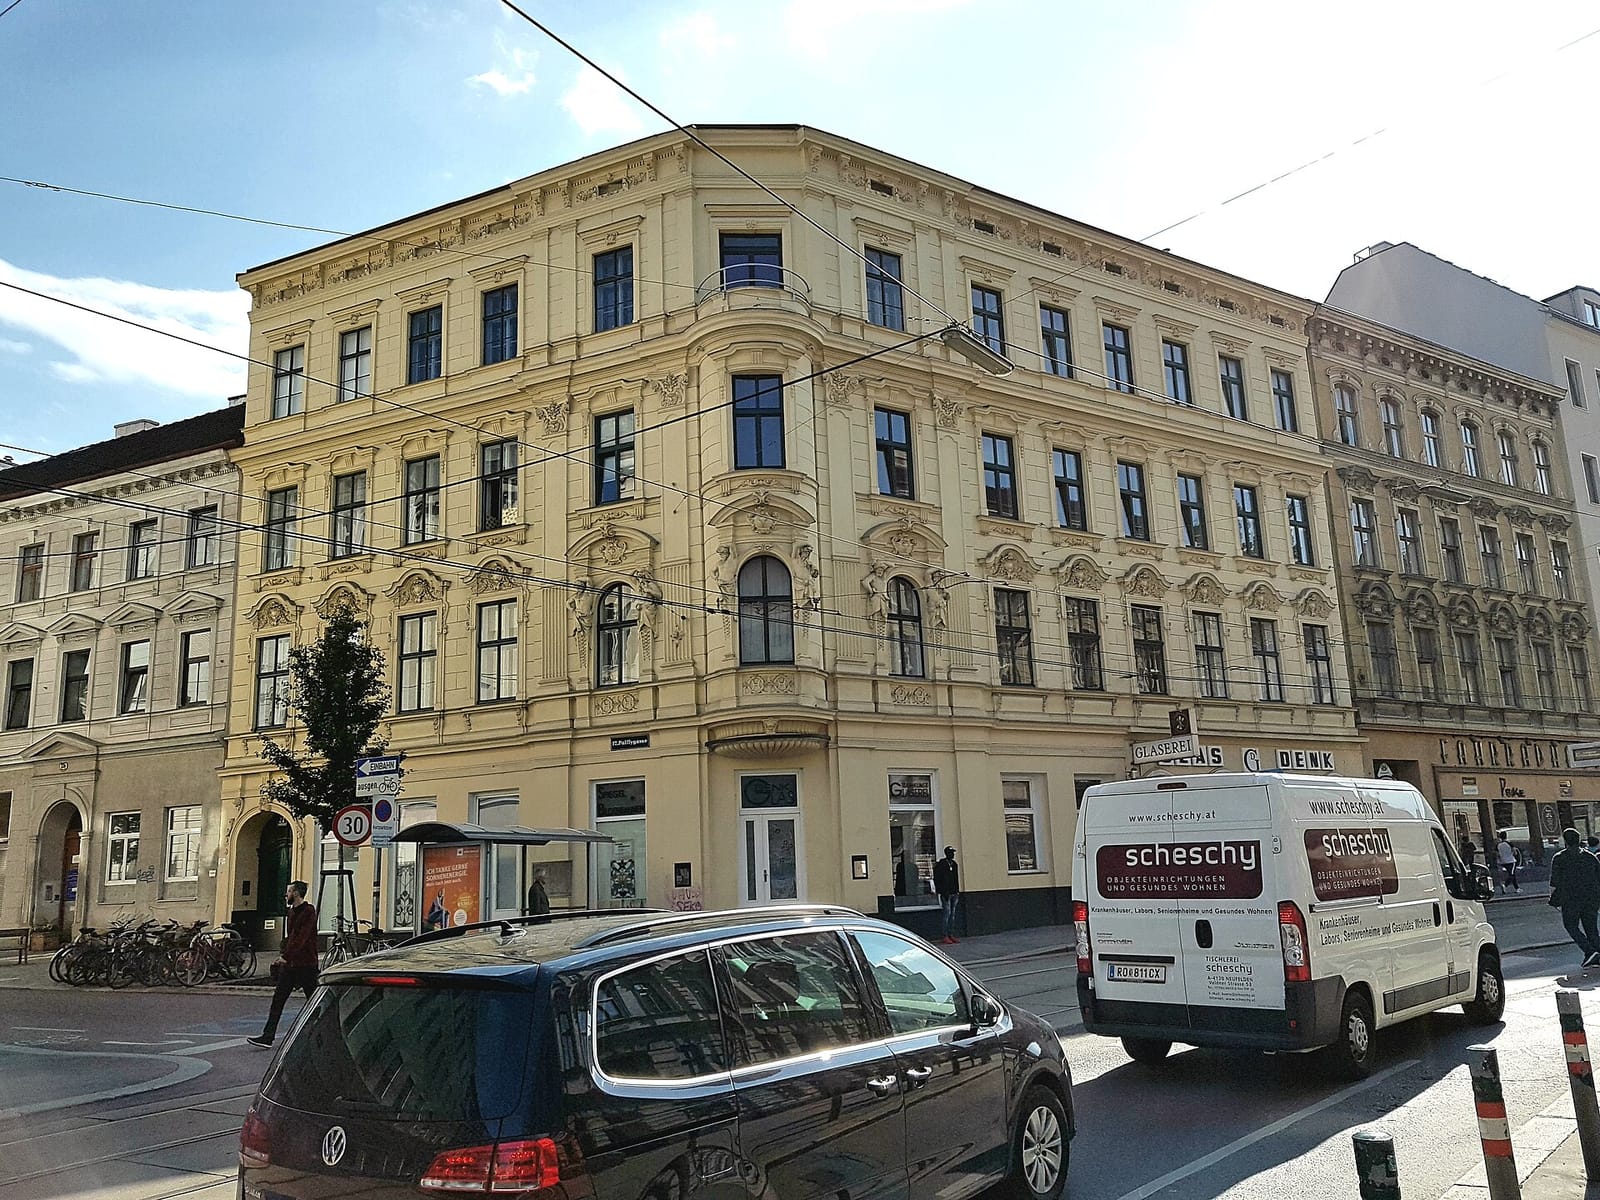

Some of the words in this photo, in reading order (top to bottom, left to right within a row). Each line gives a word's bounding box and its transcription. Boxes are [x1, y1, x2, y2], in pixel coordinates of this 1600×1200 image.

[1135, 740, 1192, 759] GLASEREI
[370, 762, 395, 771] EINBAHN
[1159, 748, 1221, 764] AS
[1280, 751, 1333, 770] DENK
[1309, 797, 1385, 818] www.scheschy.at
[1129, 810, 1216, 822] www.scheschy.at
[343, 816, 363, 834] 30
[1322, 829, 1392, 861] scheschy
[1126, 843, 1256, 870] scheschy
[1106, 875, 1225, 883] OBJEKTEINRICHTUNGEN
[1317, 867, 1382, 880] OBJEKTEINRICHTUNGEN
[1333, 880, 1361, 889] GESUNDES
[1091, 906, 1133, 914] Krankenhäuser,
[1134, 907, 1156, 915] Labors,
[1320, 913, 1362, 930] Krankenhäuser,
[1320, 933, 1343, 946] Labors,
[1343, 926, 1381, 942] Seniorenheime
[1382, 924, 1391, 934] und
[1392, 921, 1414, 933] Gesundes
[1117, 967, 1128, 977] RO
[1206, 963, 1252, 975] scheschy
